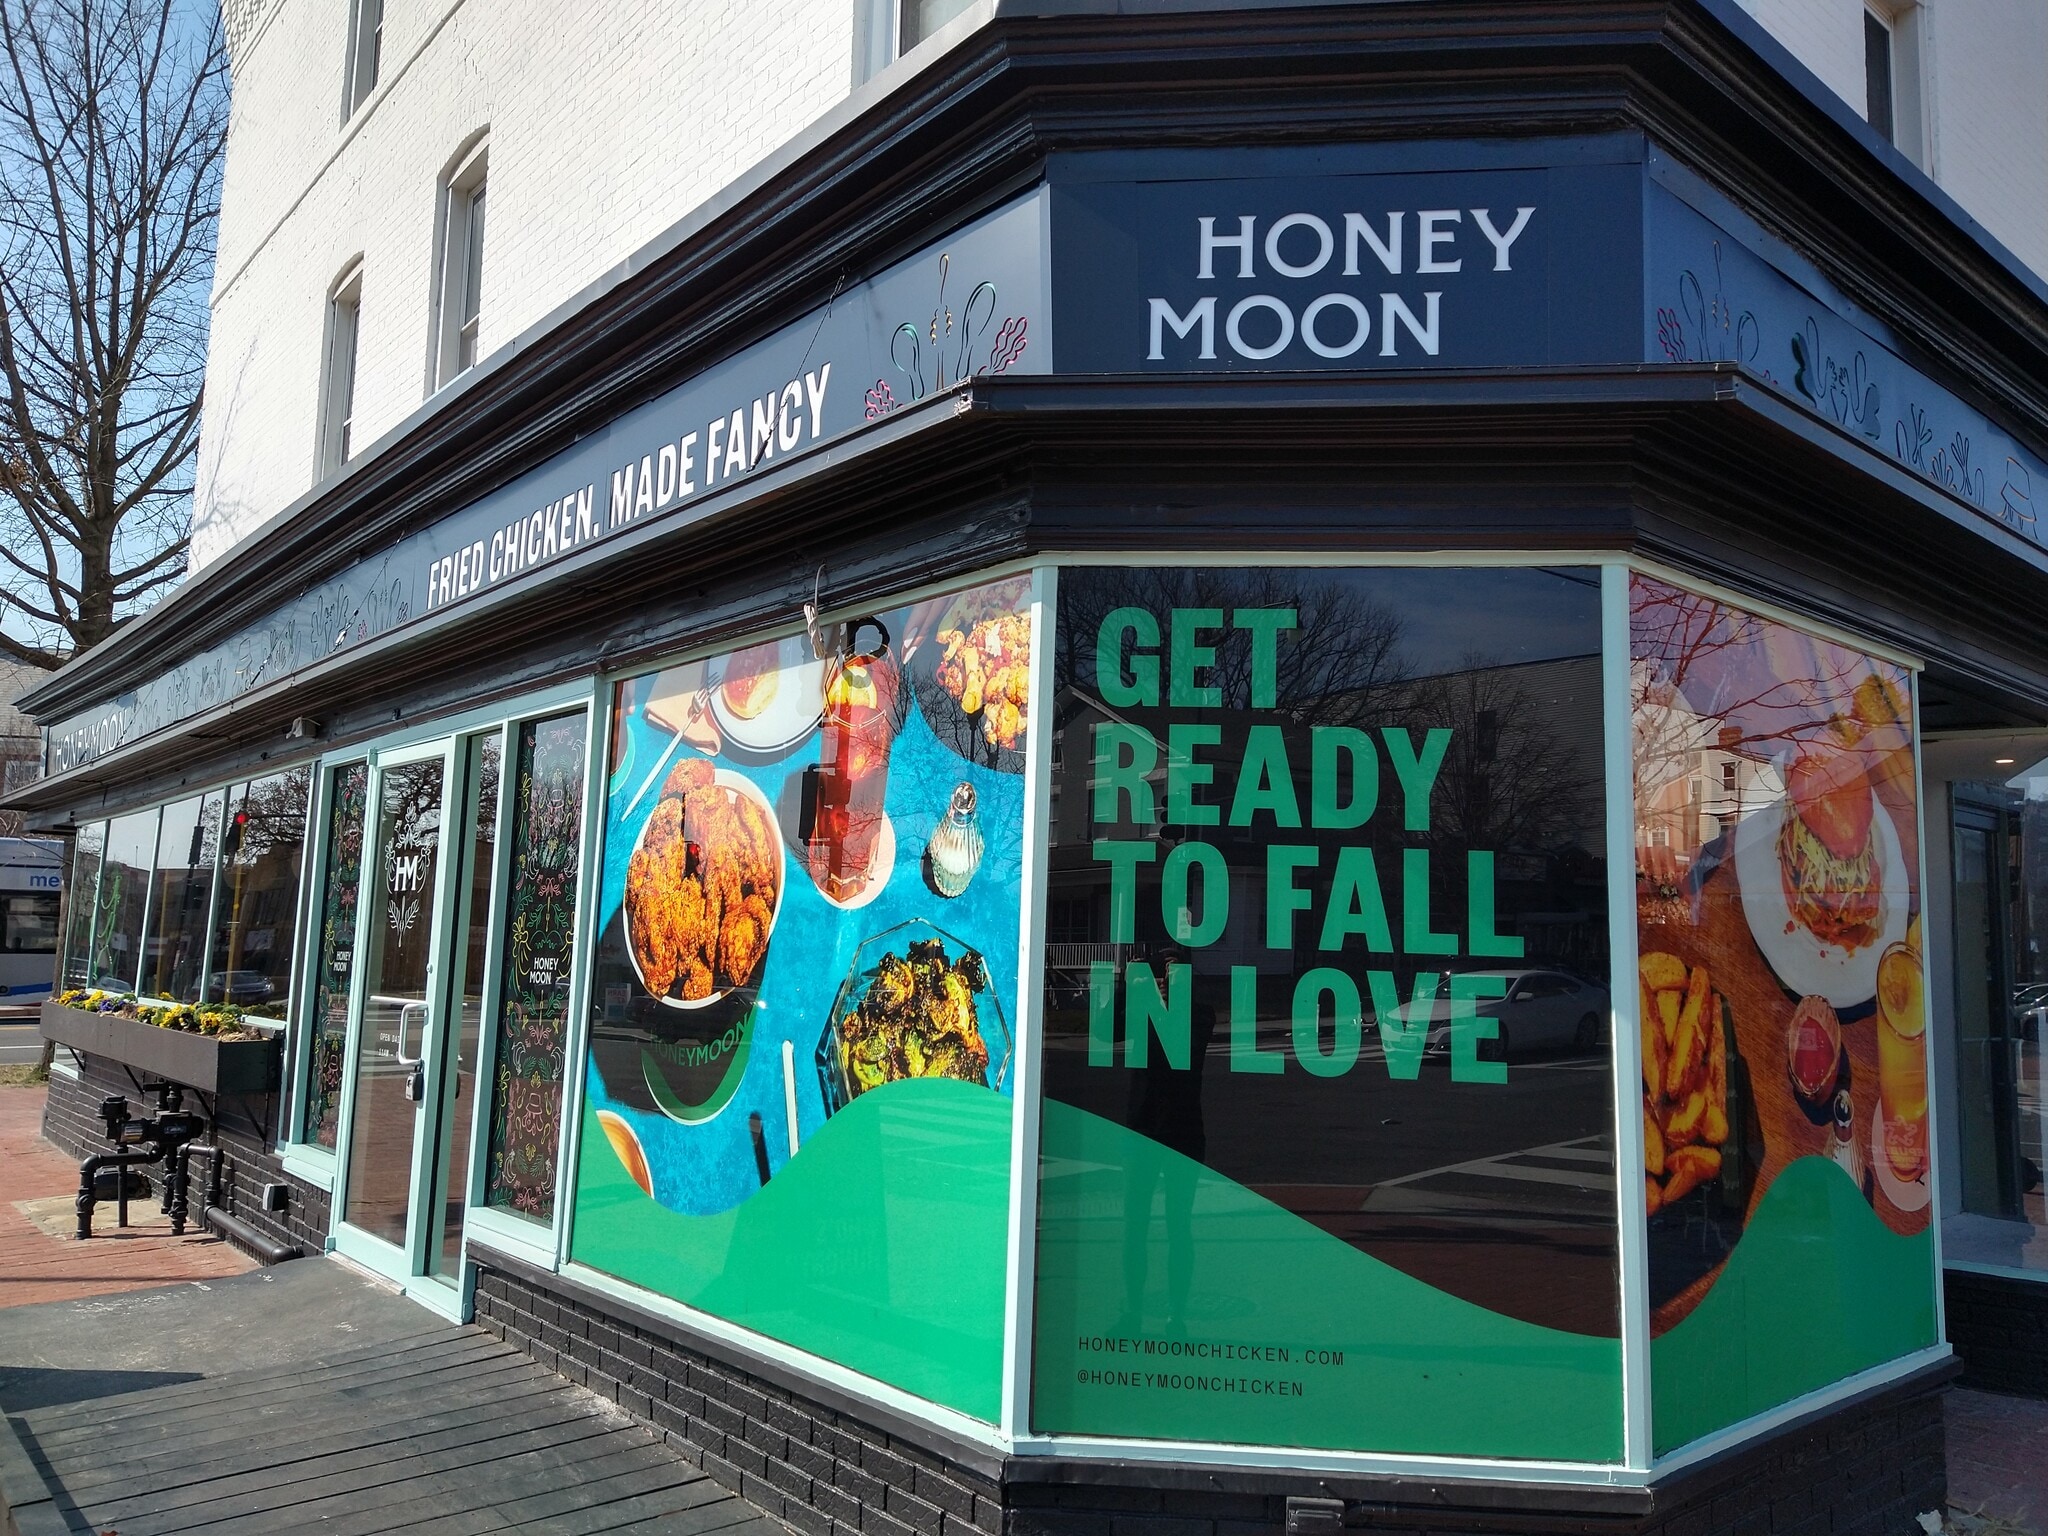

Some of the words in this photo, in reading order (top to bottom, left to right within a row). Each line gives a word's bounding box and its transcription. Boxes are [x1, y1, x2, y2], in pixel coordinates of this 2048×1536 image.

[1196, 207, 1536, 278] HONEY
[1146, 291, 1443, 360] MOON
[427, 539, 485, 609] FRIED
[610, 431, 697, 529] MADE
[705, 362, 831, 486] FANCY
[1095, 606, 1298, 709] GET
[55, 709, 128, 773] HONEYMOON
[1093, 722, 1454, 832] READY
[394, 855, 419, 892] HM
[1092, 840, 1230, 947] TO
[1266, 845, 1525, 958] FALL
[333, 961, 348, 972] MOON
[336, 951, 351, 961] HONEY
[529, 971, 552, 985] MOON
[533, 957, 559, 971] HONEY
[1088, 960, 1192, 1070] IN
[1230, 965, 1508, 1084] LOVE
[1077, 1369, 1304, 1397] @HONEYMOONCHICKEN
[1078, 1336, 1345, 1366] HONEYMOONCHICKEN.COM
